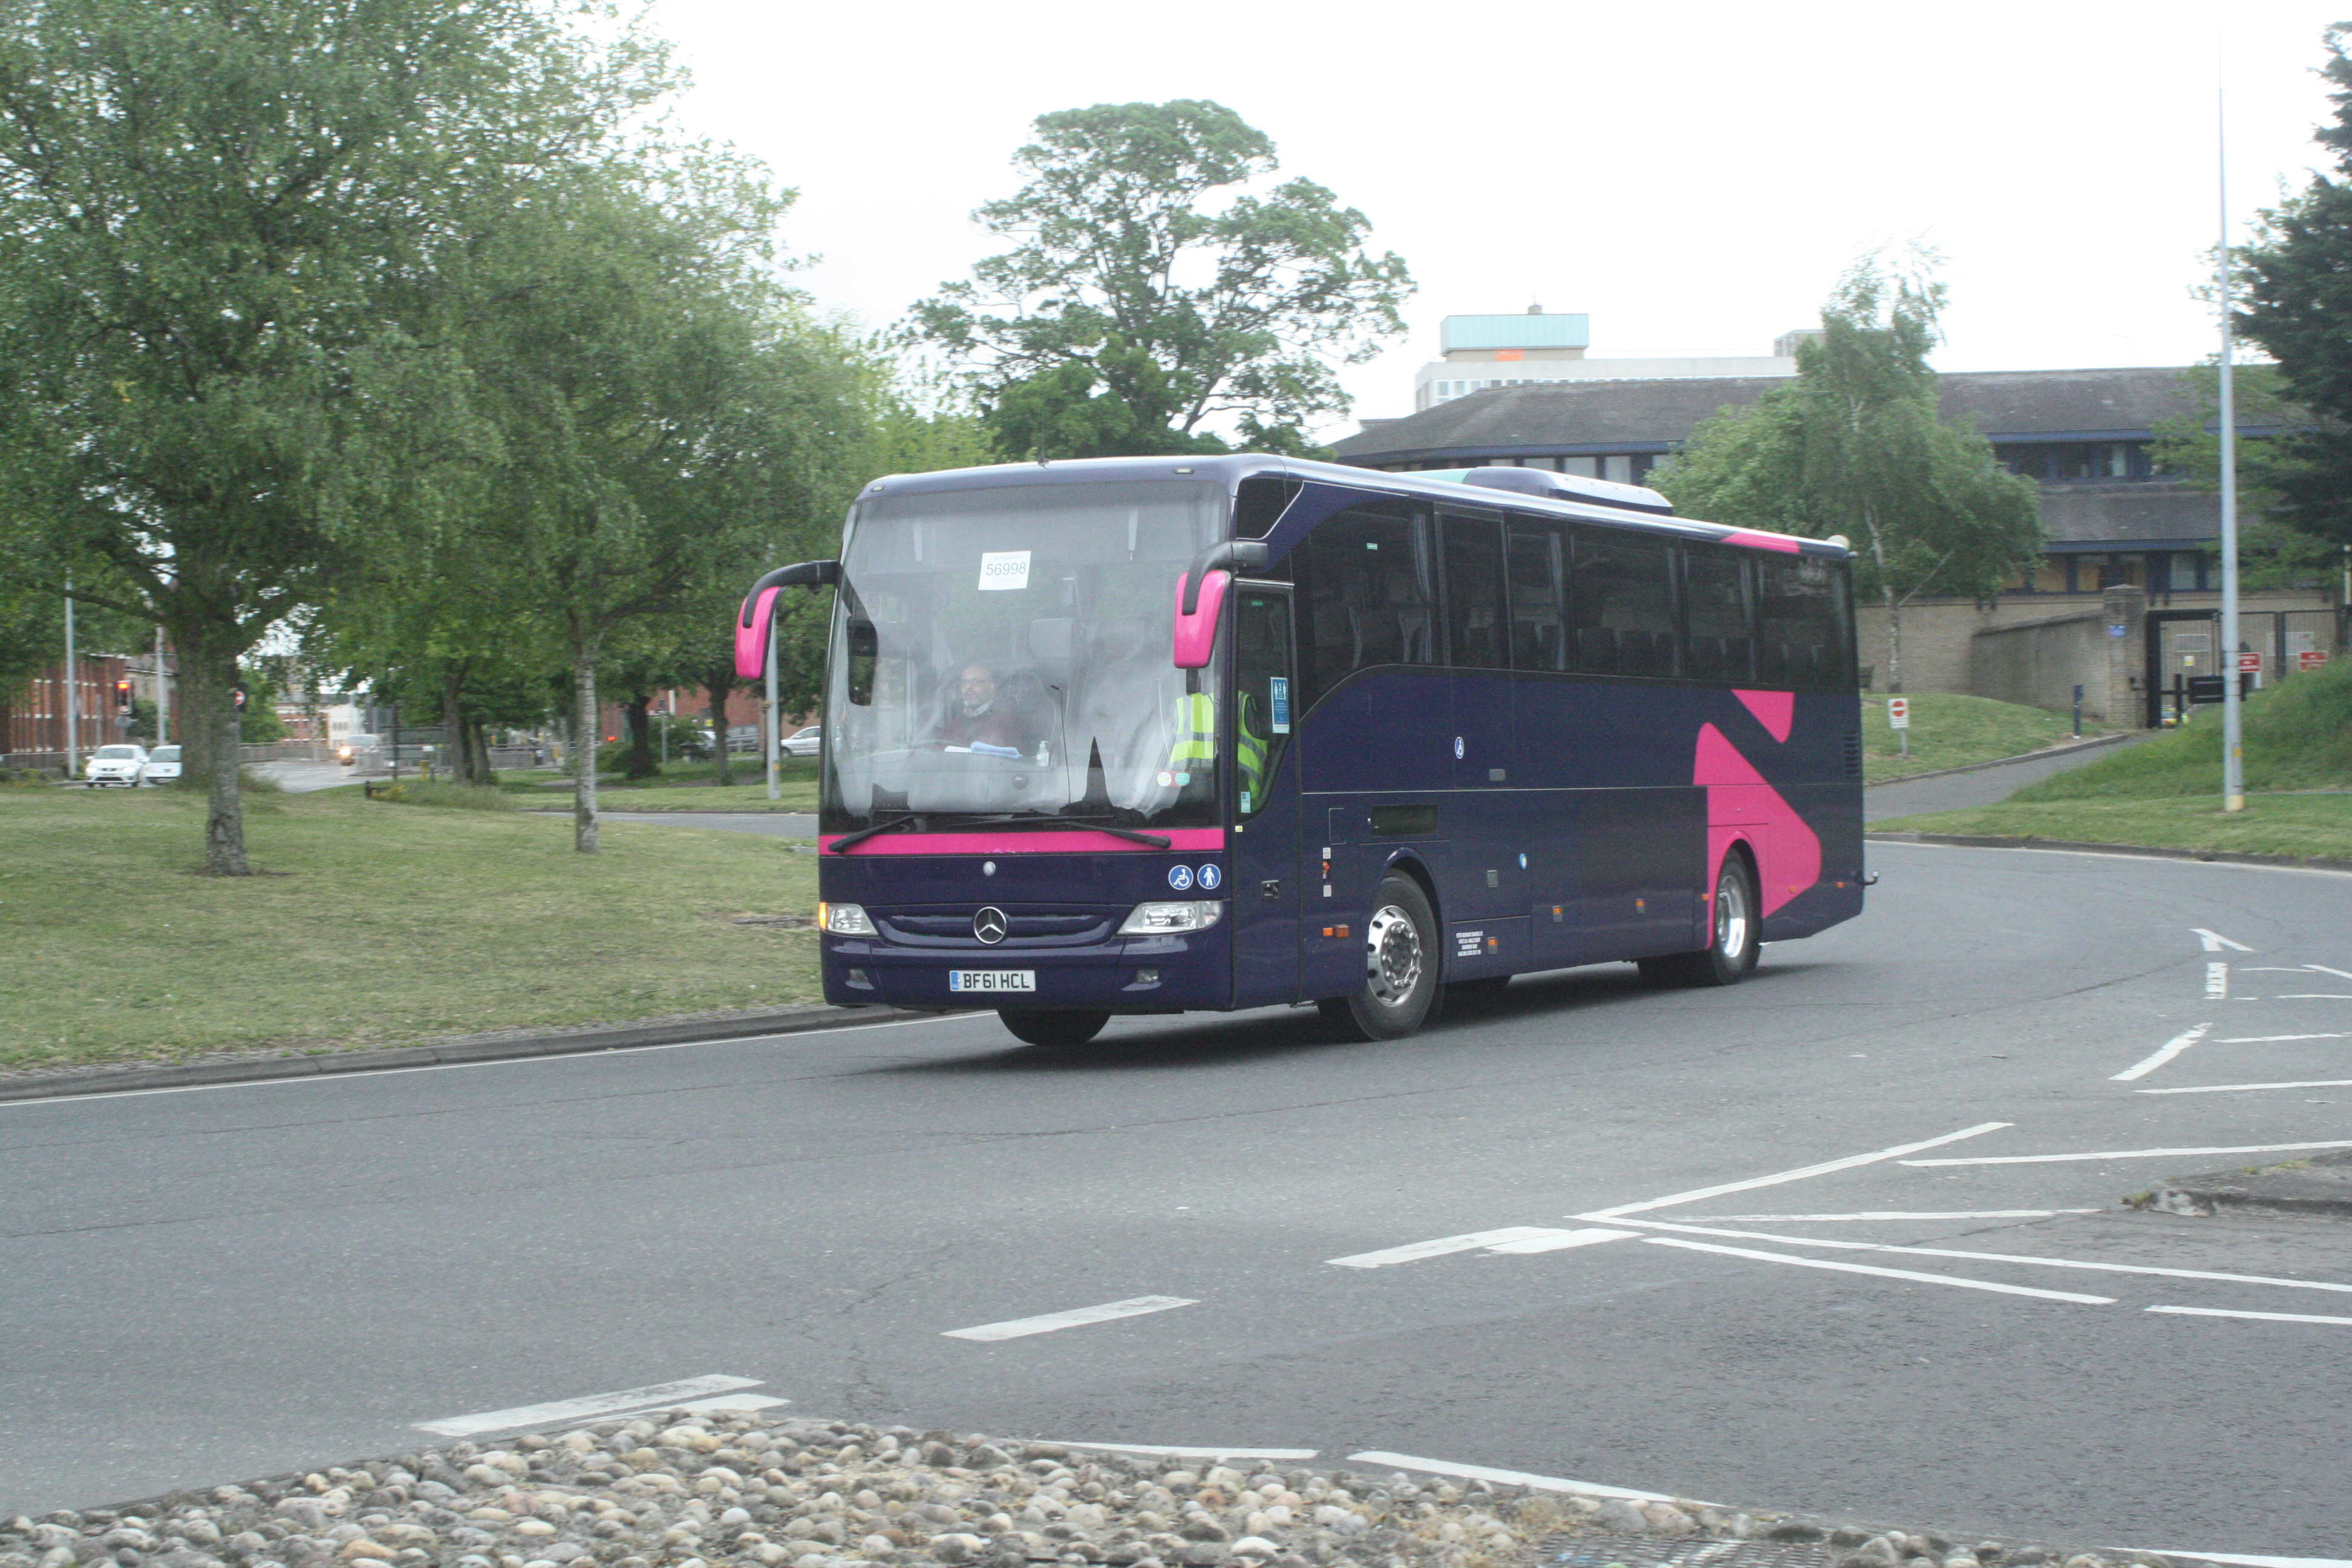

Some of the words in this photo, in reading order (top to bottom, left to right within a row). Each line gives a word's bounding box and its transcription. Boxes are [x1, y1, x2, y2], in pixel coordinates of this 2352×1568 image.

[985, 562, 1027, 576] 56998
[963, 973, 996, 988] BF61
[1000, 973, 1030, 988] HCL
